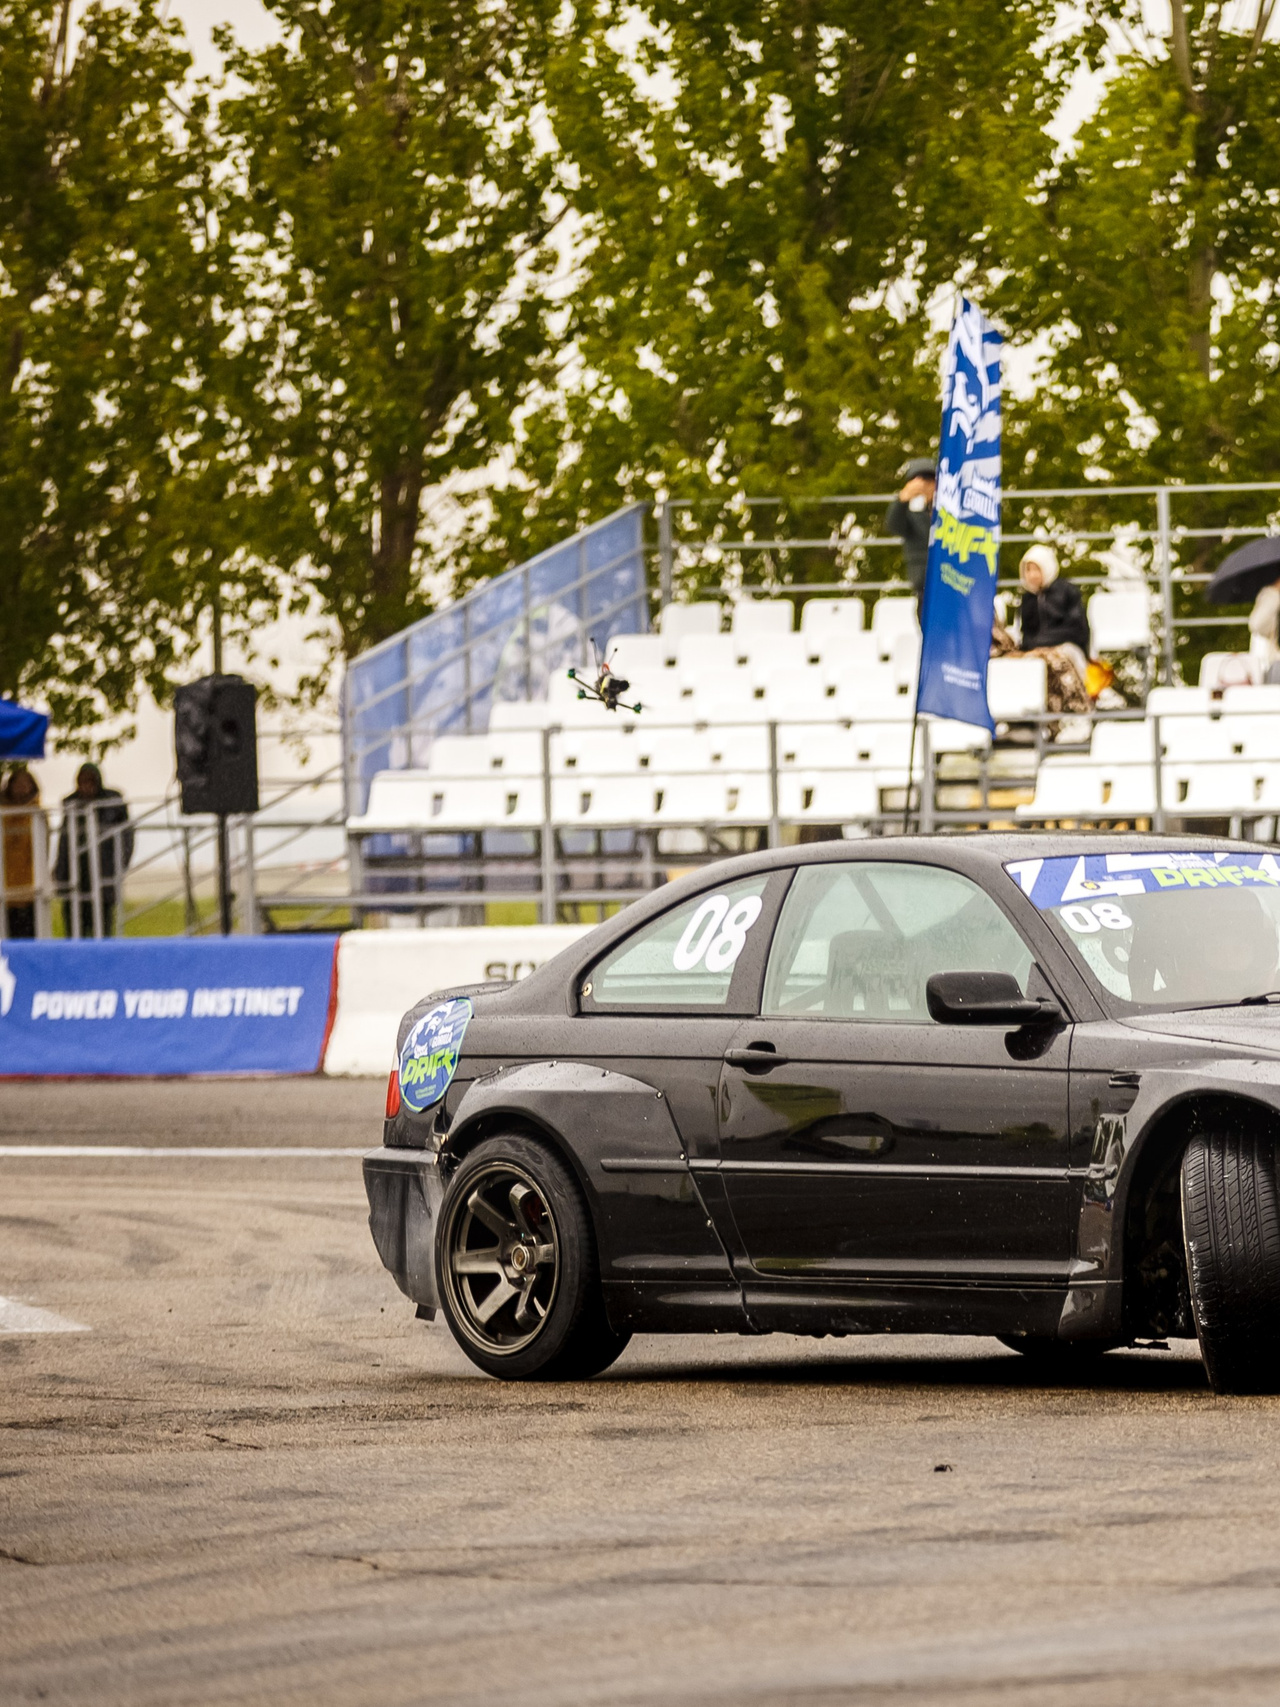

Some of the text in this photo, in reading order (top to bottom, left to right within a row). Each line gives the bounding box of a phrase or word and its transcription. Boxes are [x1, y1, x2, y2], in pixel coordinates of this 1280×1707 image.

[1150, 865, 1279, 887] DRIFT
[673, 894, 763, 973] 08
[1059, 902, 1133, 933] 08
[31, 986, 304, 1020] POWER YOUR INSTINCT
[401, 1047, 455, 1086] DRIFT
